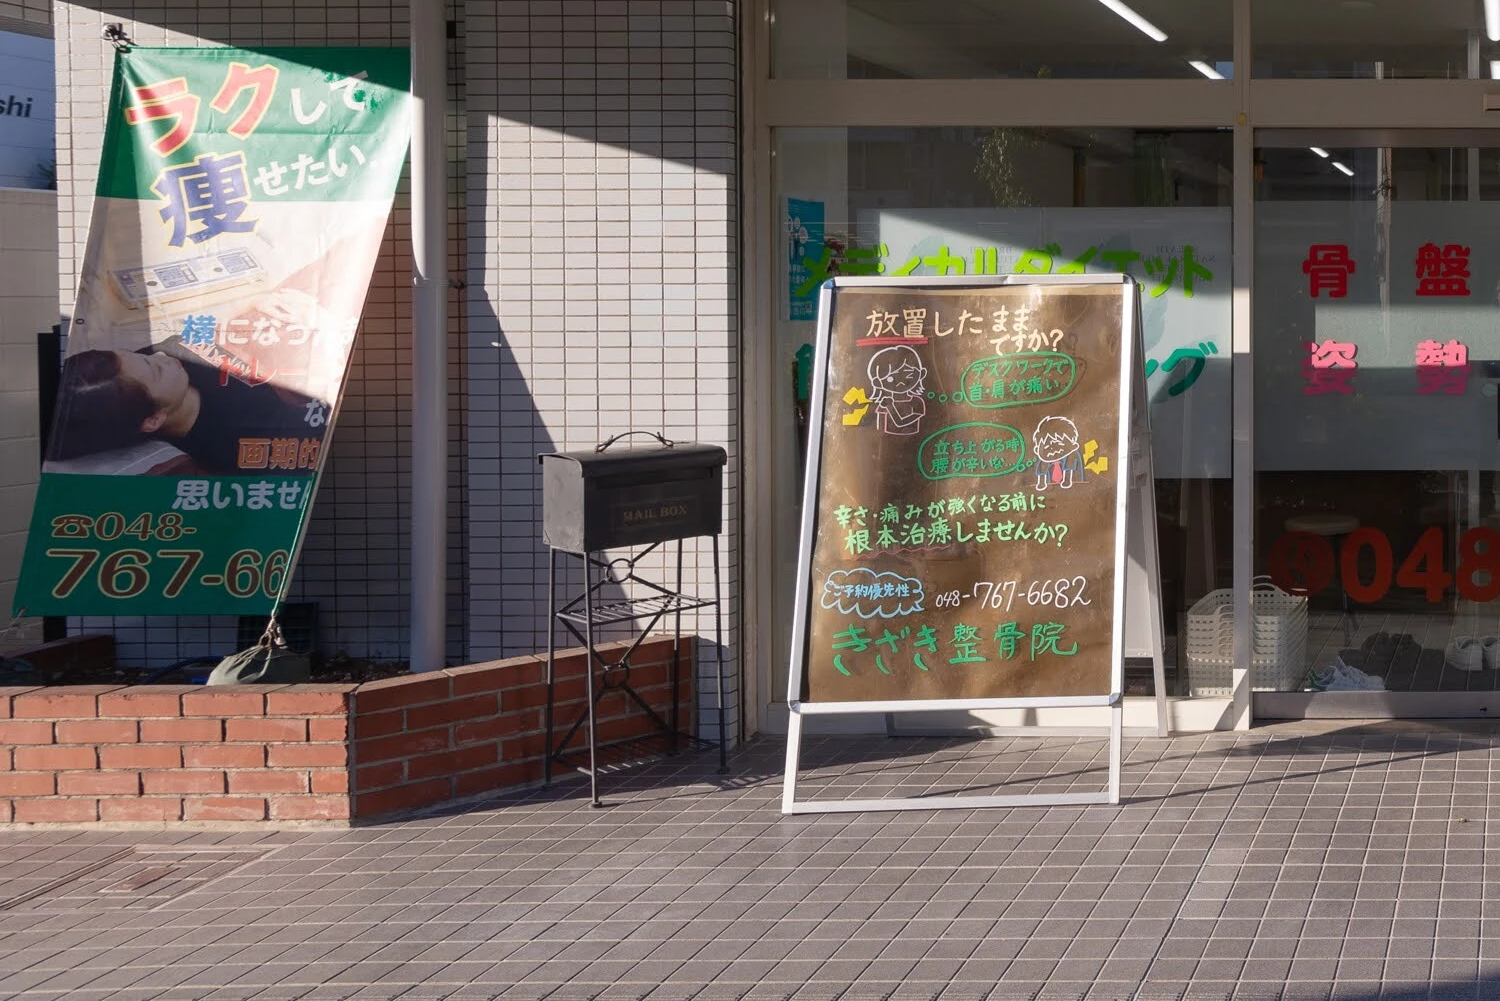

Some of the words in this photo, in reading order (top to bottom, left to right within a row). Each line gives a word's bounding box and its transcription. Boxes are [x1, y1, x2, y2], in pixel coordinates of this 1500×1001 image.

[125, 62, 368, 157] ラクして
[866, 304, 1031, 340] 放置したまま
[970, 357, 1070, 380] デスクワークで
[933, 436, 1020, 456] 立ち上がる時
[623, 509, 655, 521] MAIL
[660, 504, 687, 517] BOX
[833, 494, 1046, 528] 辛さ・痛みが強くなる前に
[832, 582, 910, 601] ご予約優先性
[935, 575, 1092, 612] 048-767-6682
[832, 621, 1079, 677] きざき整骨院
